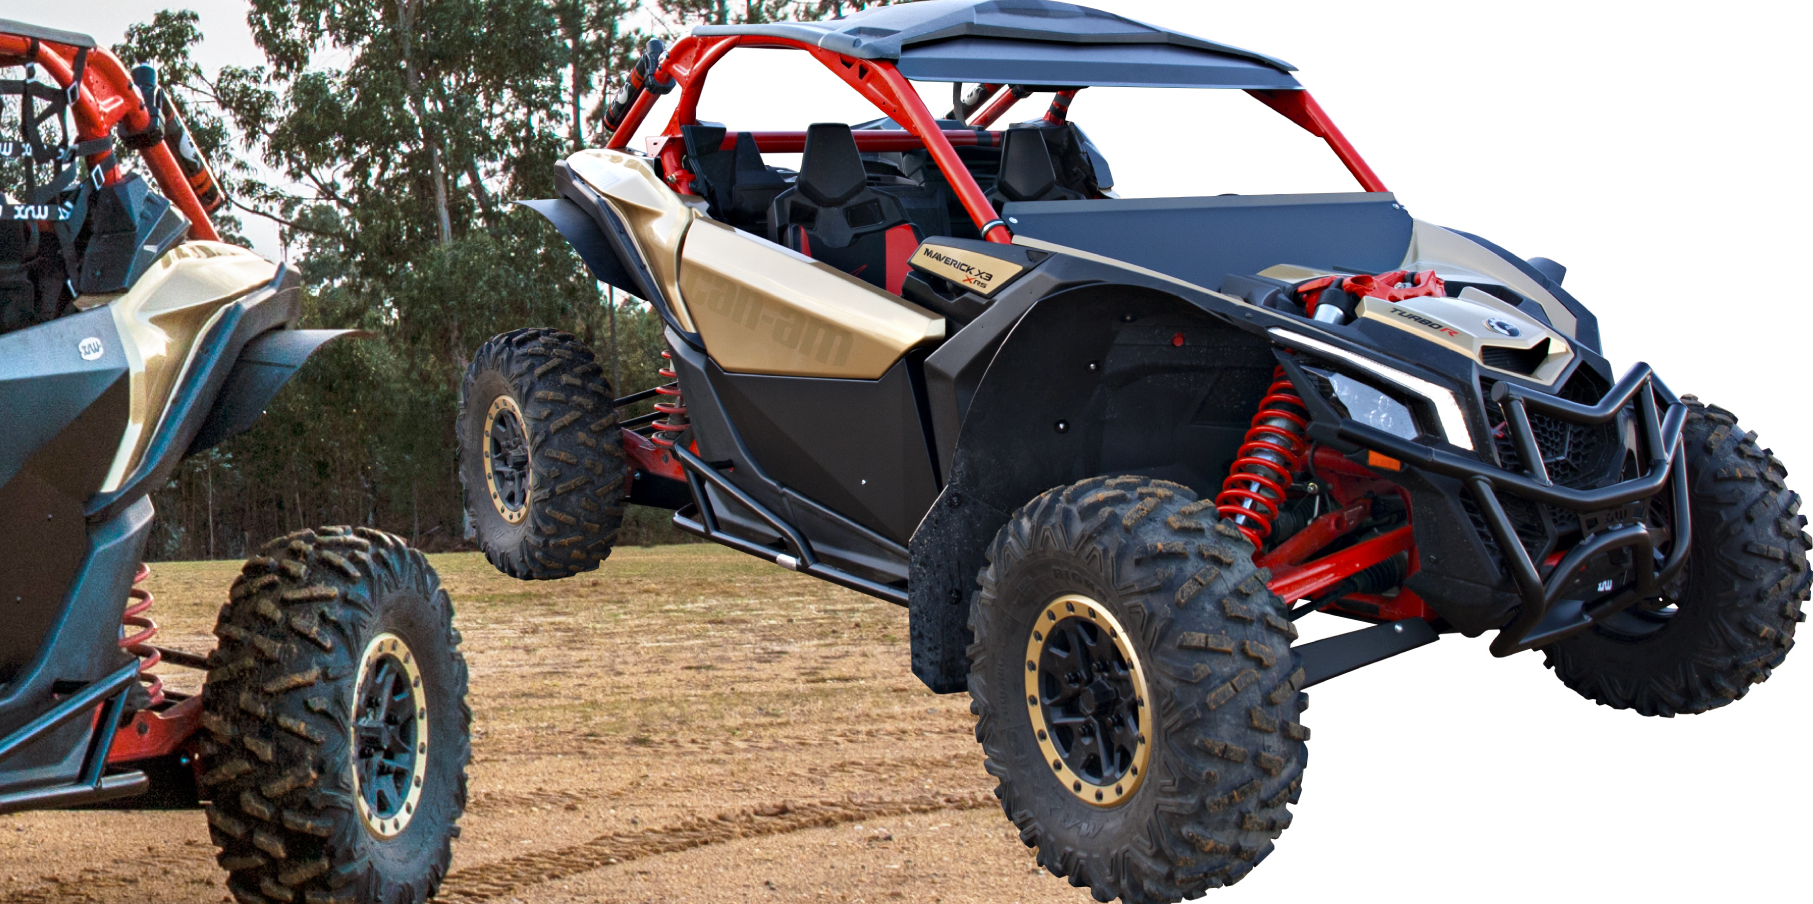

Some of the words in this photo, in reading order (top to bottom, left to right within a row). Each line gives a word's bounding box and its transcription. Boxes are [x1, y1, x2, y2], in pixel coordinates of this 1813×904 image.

[923, 247, 976, 276] MAVERICK
[973, 269, 994, 282] X3
[684, 270, 854, 367] can-am
